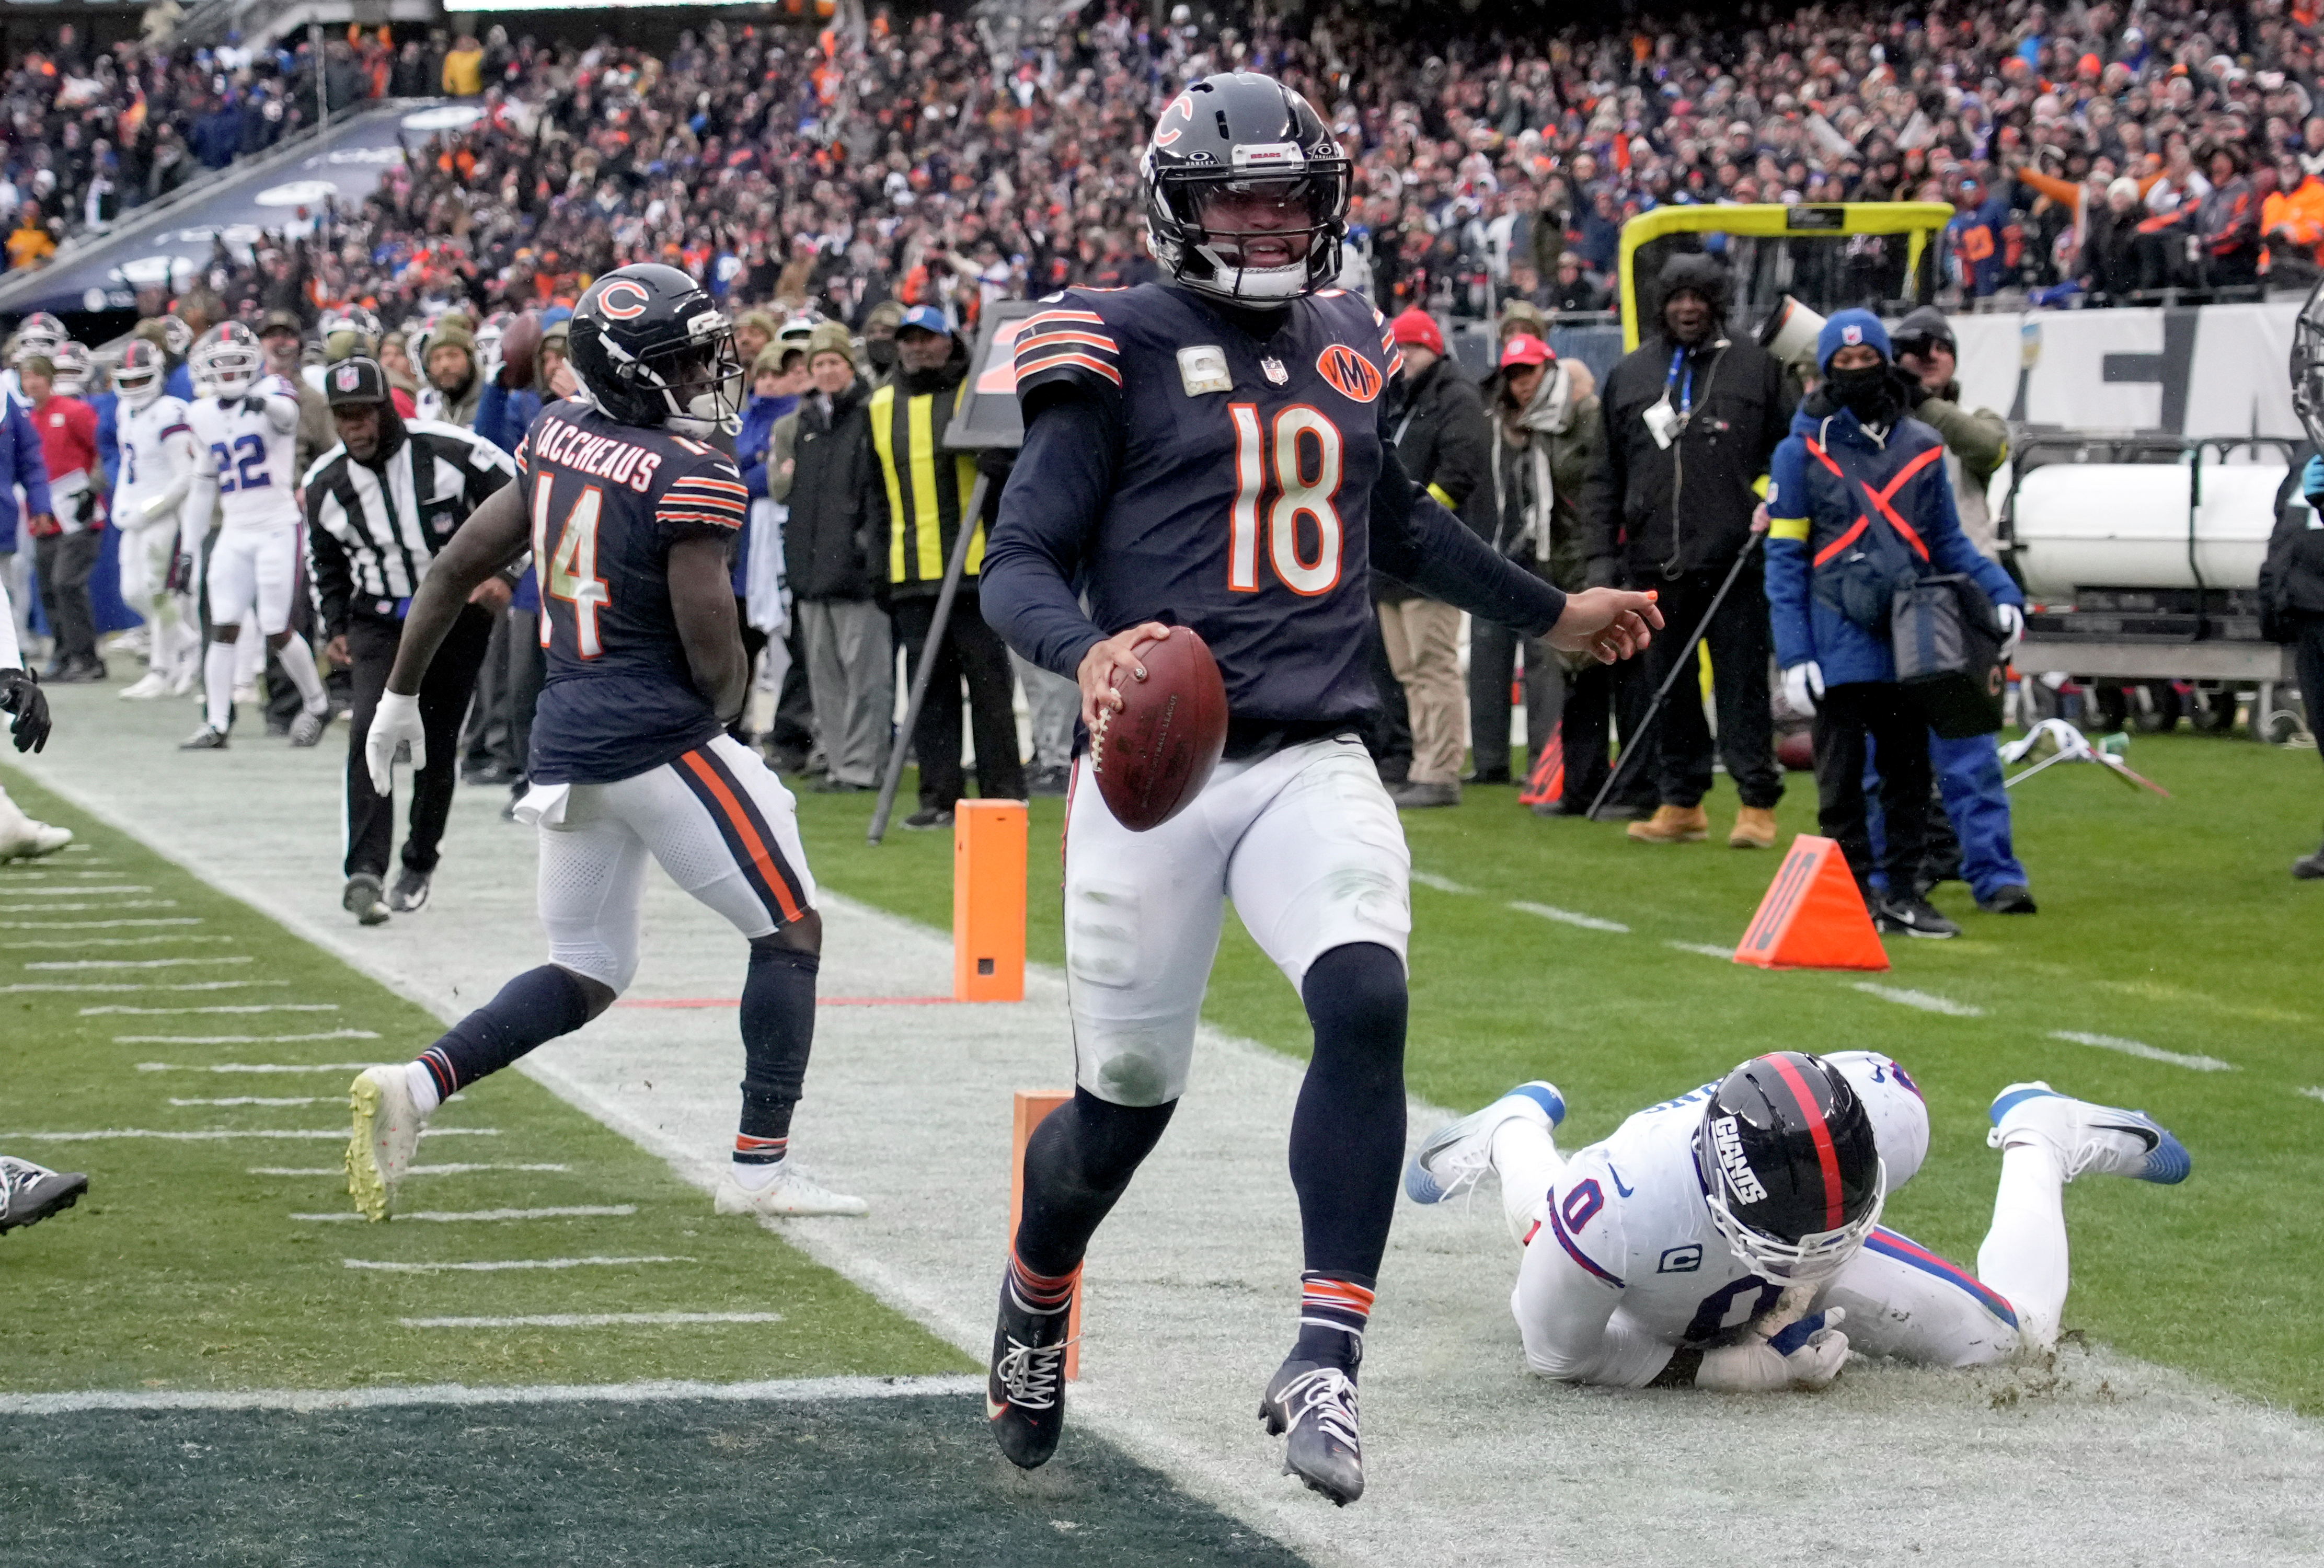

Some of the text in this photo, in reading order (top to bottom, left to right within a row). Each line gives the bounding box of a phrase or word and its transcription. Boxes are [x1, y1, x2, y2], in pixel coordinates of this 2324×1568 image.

[597, 281, 649, 320] C
[211, 434, 272, 494] 22
[1227, 402, 1343, 596] 18
[533, 471, 611, 660] 14
[1715, 1116, 1768, 1204] GIANTS
[1562, 1178, 1604, 1235] 0
